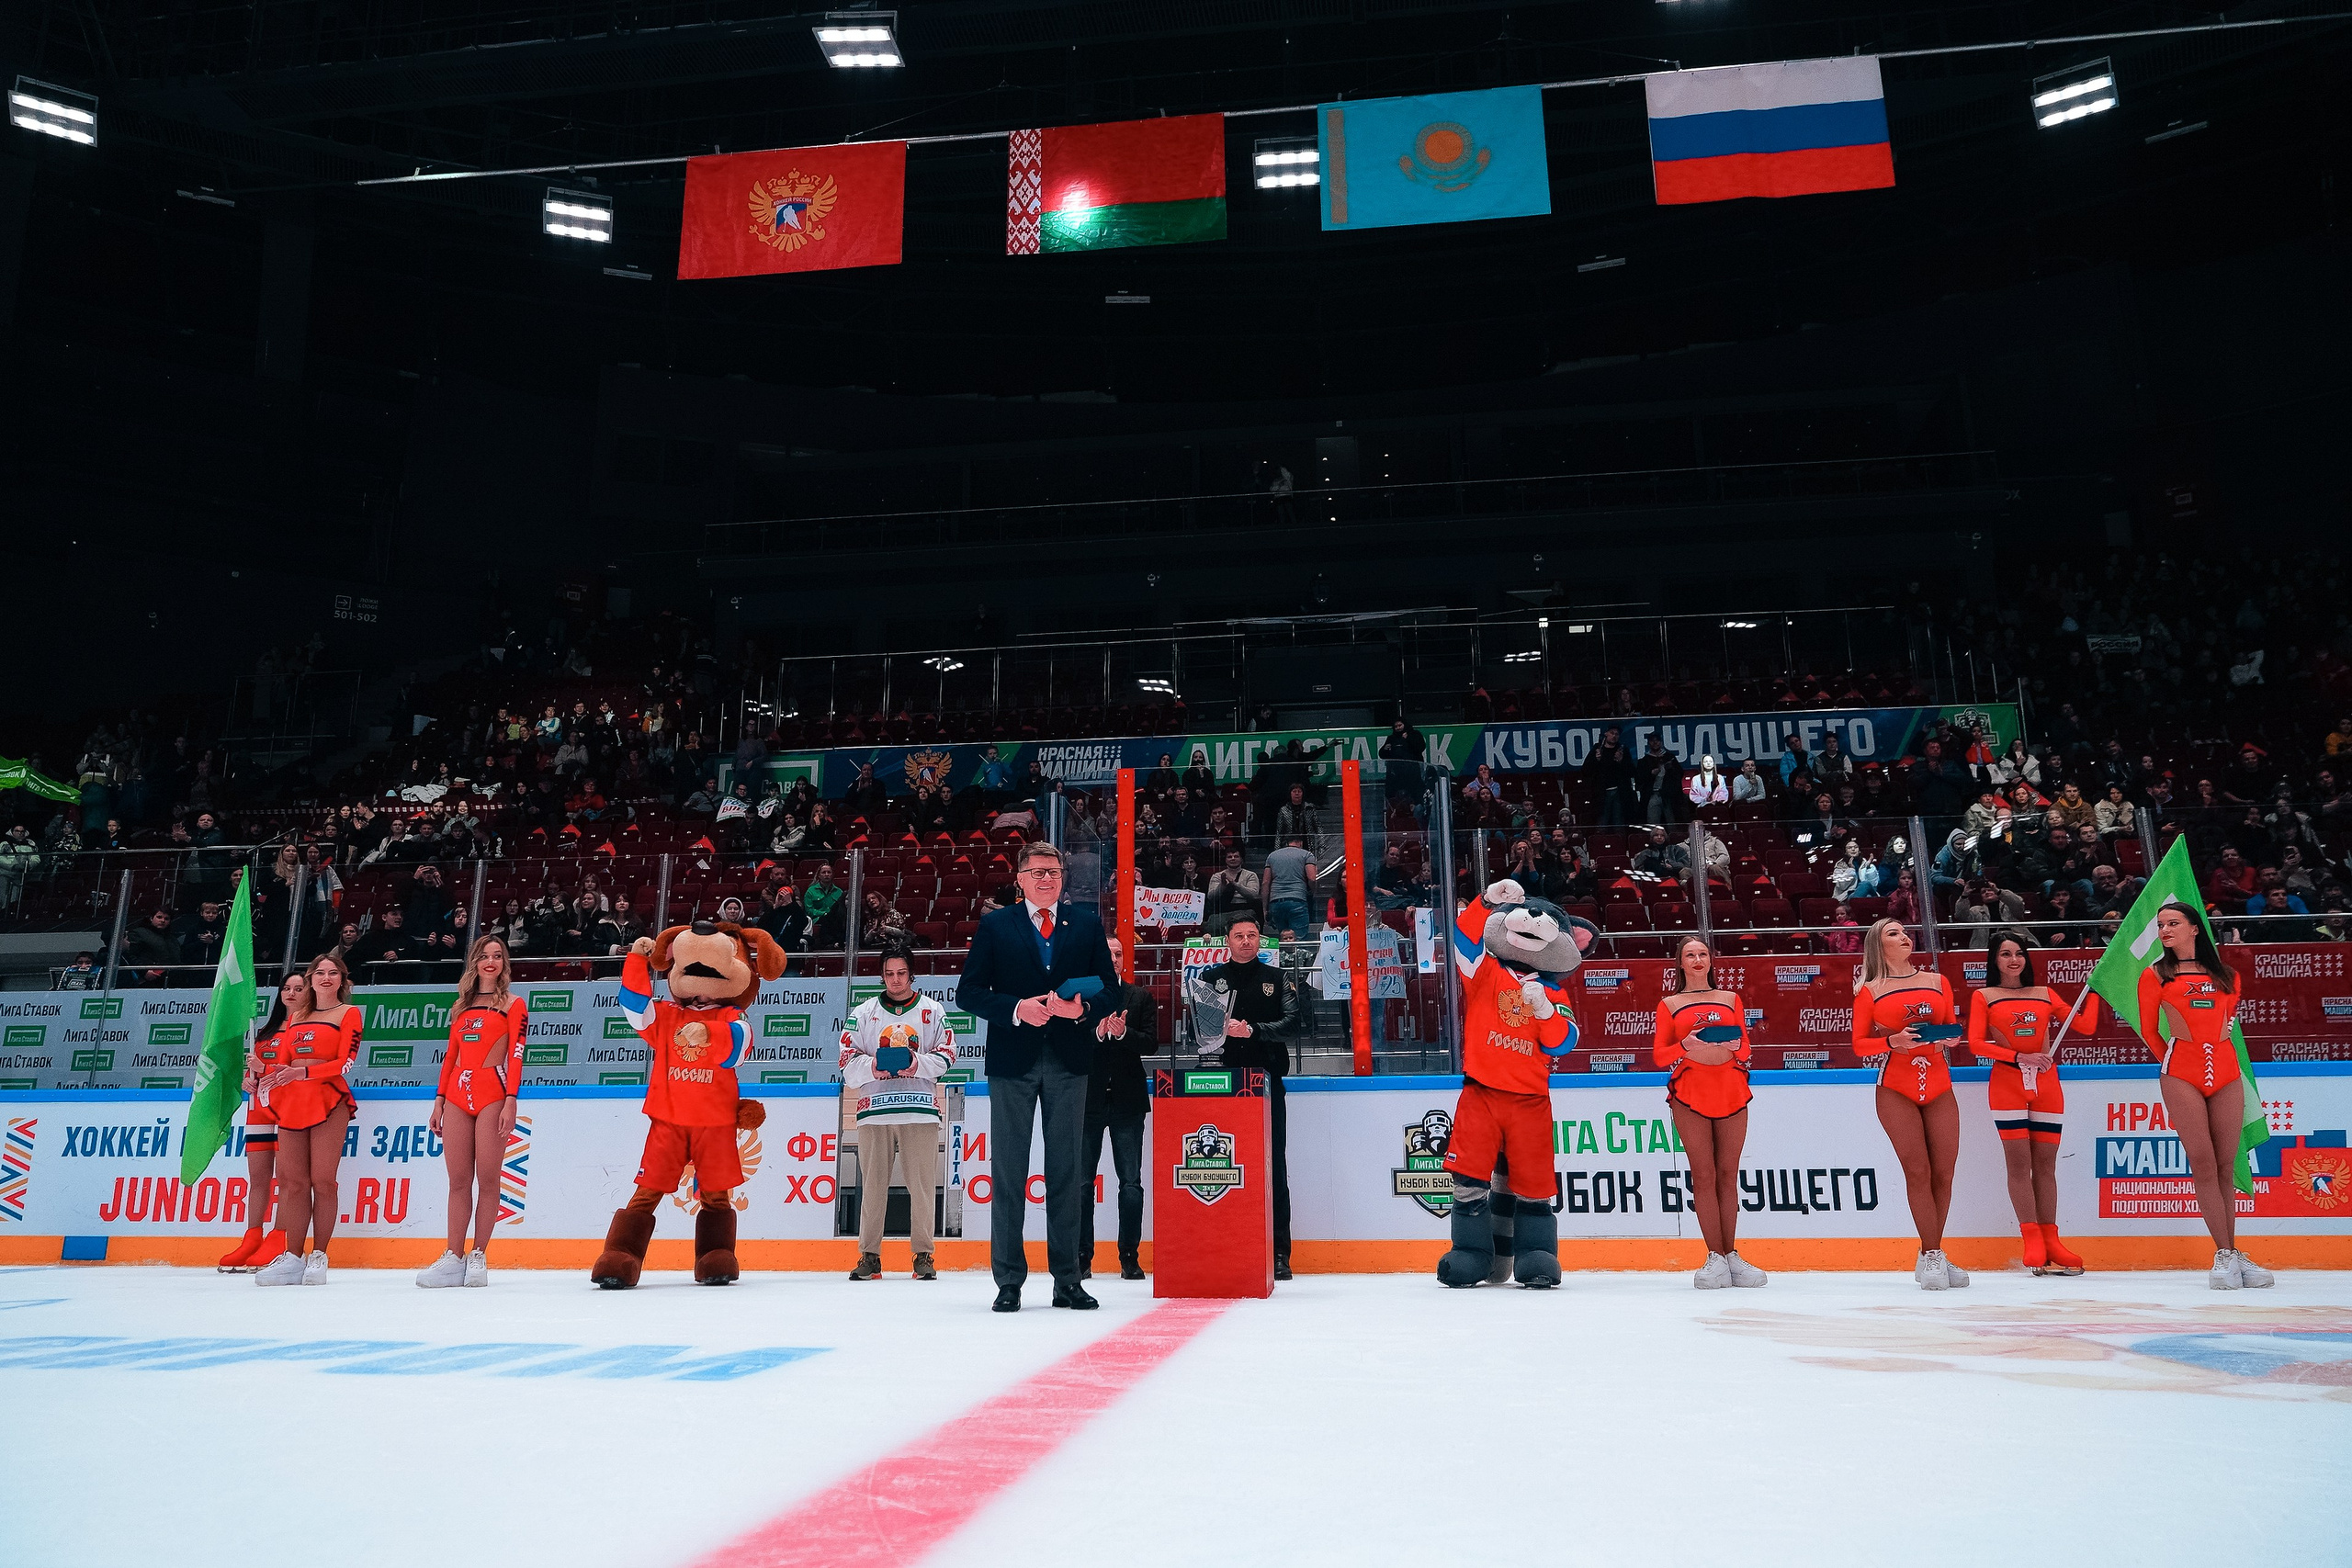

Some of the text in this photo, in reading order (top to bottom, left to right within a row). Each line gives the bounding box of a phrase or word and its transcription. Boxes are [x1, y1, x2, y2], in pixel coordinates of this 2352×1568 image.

[334, 610, 378, 623] 501-502
[1037, 746, 1102, 761] КРАСНАЯ
[1184, 948, 1230, 964] РОСС
[2255, 953, 2312, 964] КРАСНАЯ
[2255, 965, 2312, 978] МАШИНА
[1585, 978, 1617, 987] МАШИНА
[1776, 975, 1809, 983] МАШИНА
[782, 990, 825, 1005] СТАВОК
[23, 1002, 62, 1017] СТАВОК
[141, 1000, 208, 1015] ЛИГА СТАВОК
[1799, 1009, 1853, 1019] КРАСНАЯ
[371, 1003, 453, 1029] ЛИГА СТА
[922, 1009, 932, 1024] C
[1606, 1012, 1657, 1021] КРАСНАЯ
[541, 1021, 582, 1036] СТАВОК
[1604, 1023, 1657, 1035] МАШИНА
[1798, 1020, 1853, 1032] МАШИНА
[63, 1029, 88, 1043] ЛИГА
[840, 1032, 852, 1048] 4
[1487, 1030, 1534, 1056] РОССИЯ
[586, 1048, 615, 1062] ЛИГА
[778, 1045, 822, 1059] СТАВОК
[2061, 1047, 2117, 1058] КРАСНАЯ
[2271, 1043, 2329, 1054] КРАСНАЯ
[14, 1054, 52, 1068] СТАВОК
[131, 1053, 199, 1066] ЛИГА СТАВОК
[1784, 1061, 1817, 1069] МАШИНА
[668, 1066, 714, 1084] РОССИЯ
[1591, 1064, 1623, 1072] МАШИНА
[1192, 1082, 1226, 1090] ЛИГА СТАВОК
[871, 1095, 933, 1106] BELARUSKALI
[62, 1117, 170, 1157] ХОККЕЙ
[1605, 1111, 1685, 1154] СТА
[370, 1125, 445, 1163] ЗДЕС
[952, 1125, 962, 1186] RAITA
[2106, 1140, 2260, 1175] МАША
[1191, 1158, 1227, 1168] ЛИГА СТАВОК
[1414, 1158, 1434, 1169] ЛИГА
[1181, 1172, 1237, 1181] КУБОК БУДУЩЕГО
[1400, 1177, 1455, 1189] КУБОК БУДУ
[1659, 1168, 1879, 1215] БУЩЕГО
[98, 1177, 411, 1224] JUNIOR.RU
[2111, 1199, 2183, 1214] ПОДГОТОВКИ
